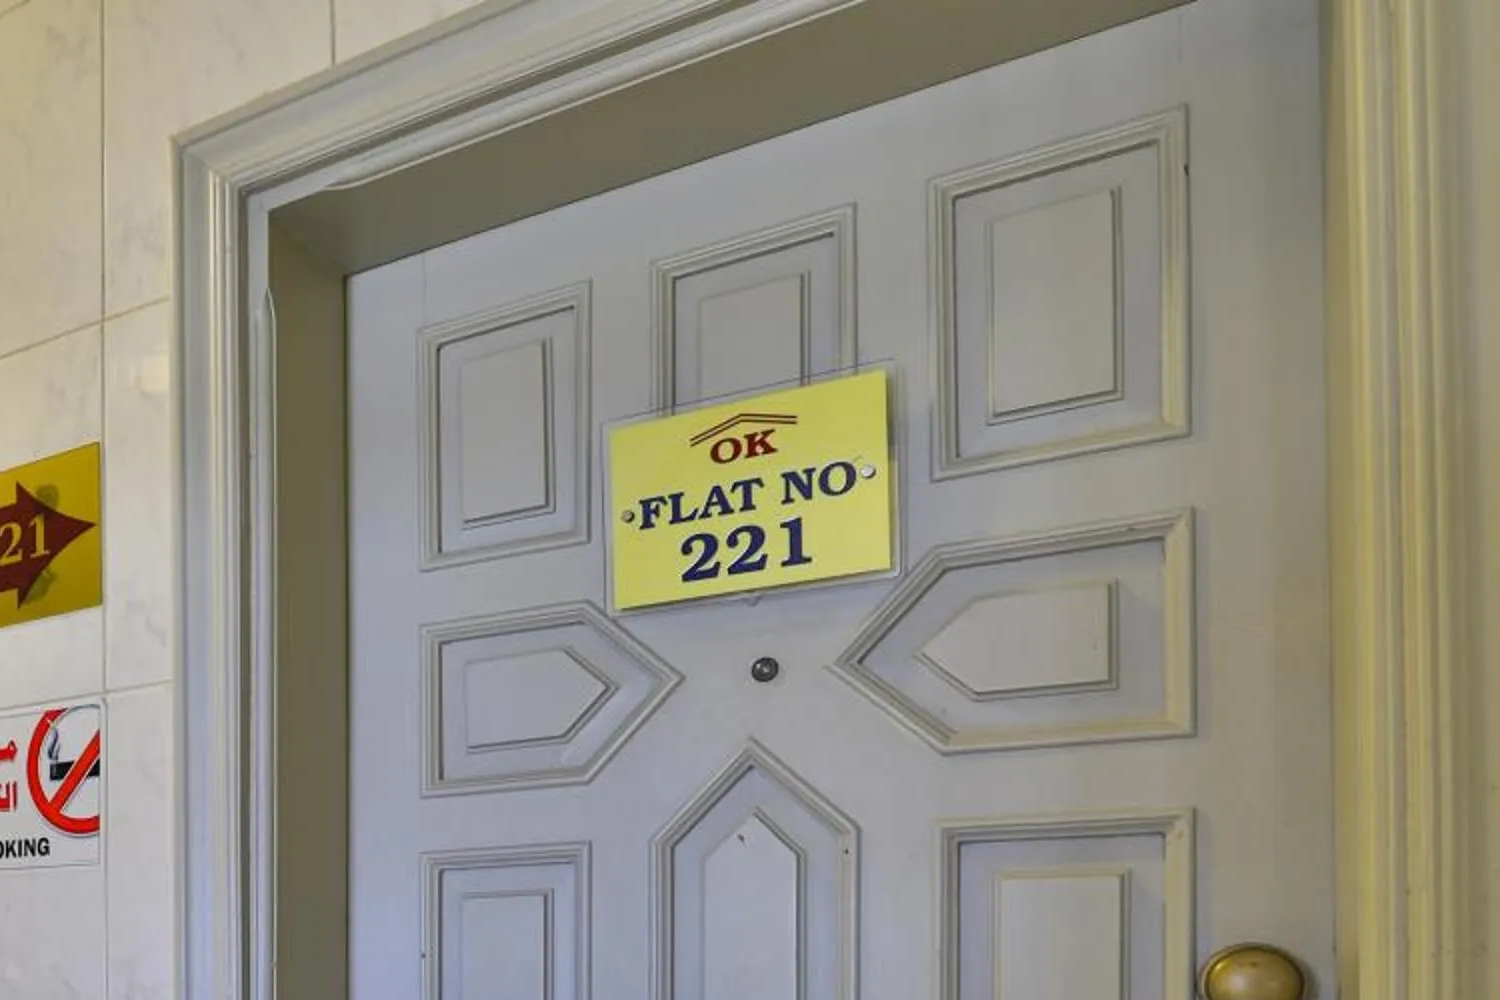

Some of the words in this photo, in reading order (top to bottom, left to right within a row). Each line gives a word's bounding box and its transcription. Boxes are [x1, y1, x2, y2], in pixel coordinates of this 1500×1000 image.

[709, 428, 778, 464] OK
[638, 478, 764, 530] FLAT
[781, 461, 857, 505] NO
[680, 517, 812, 583] 221
